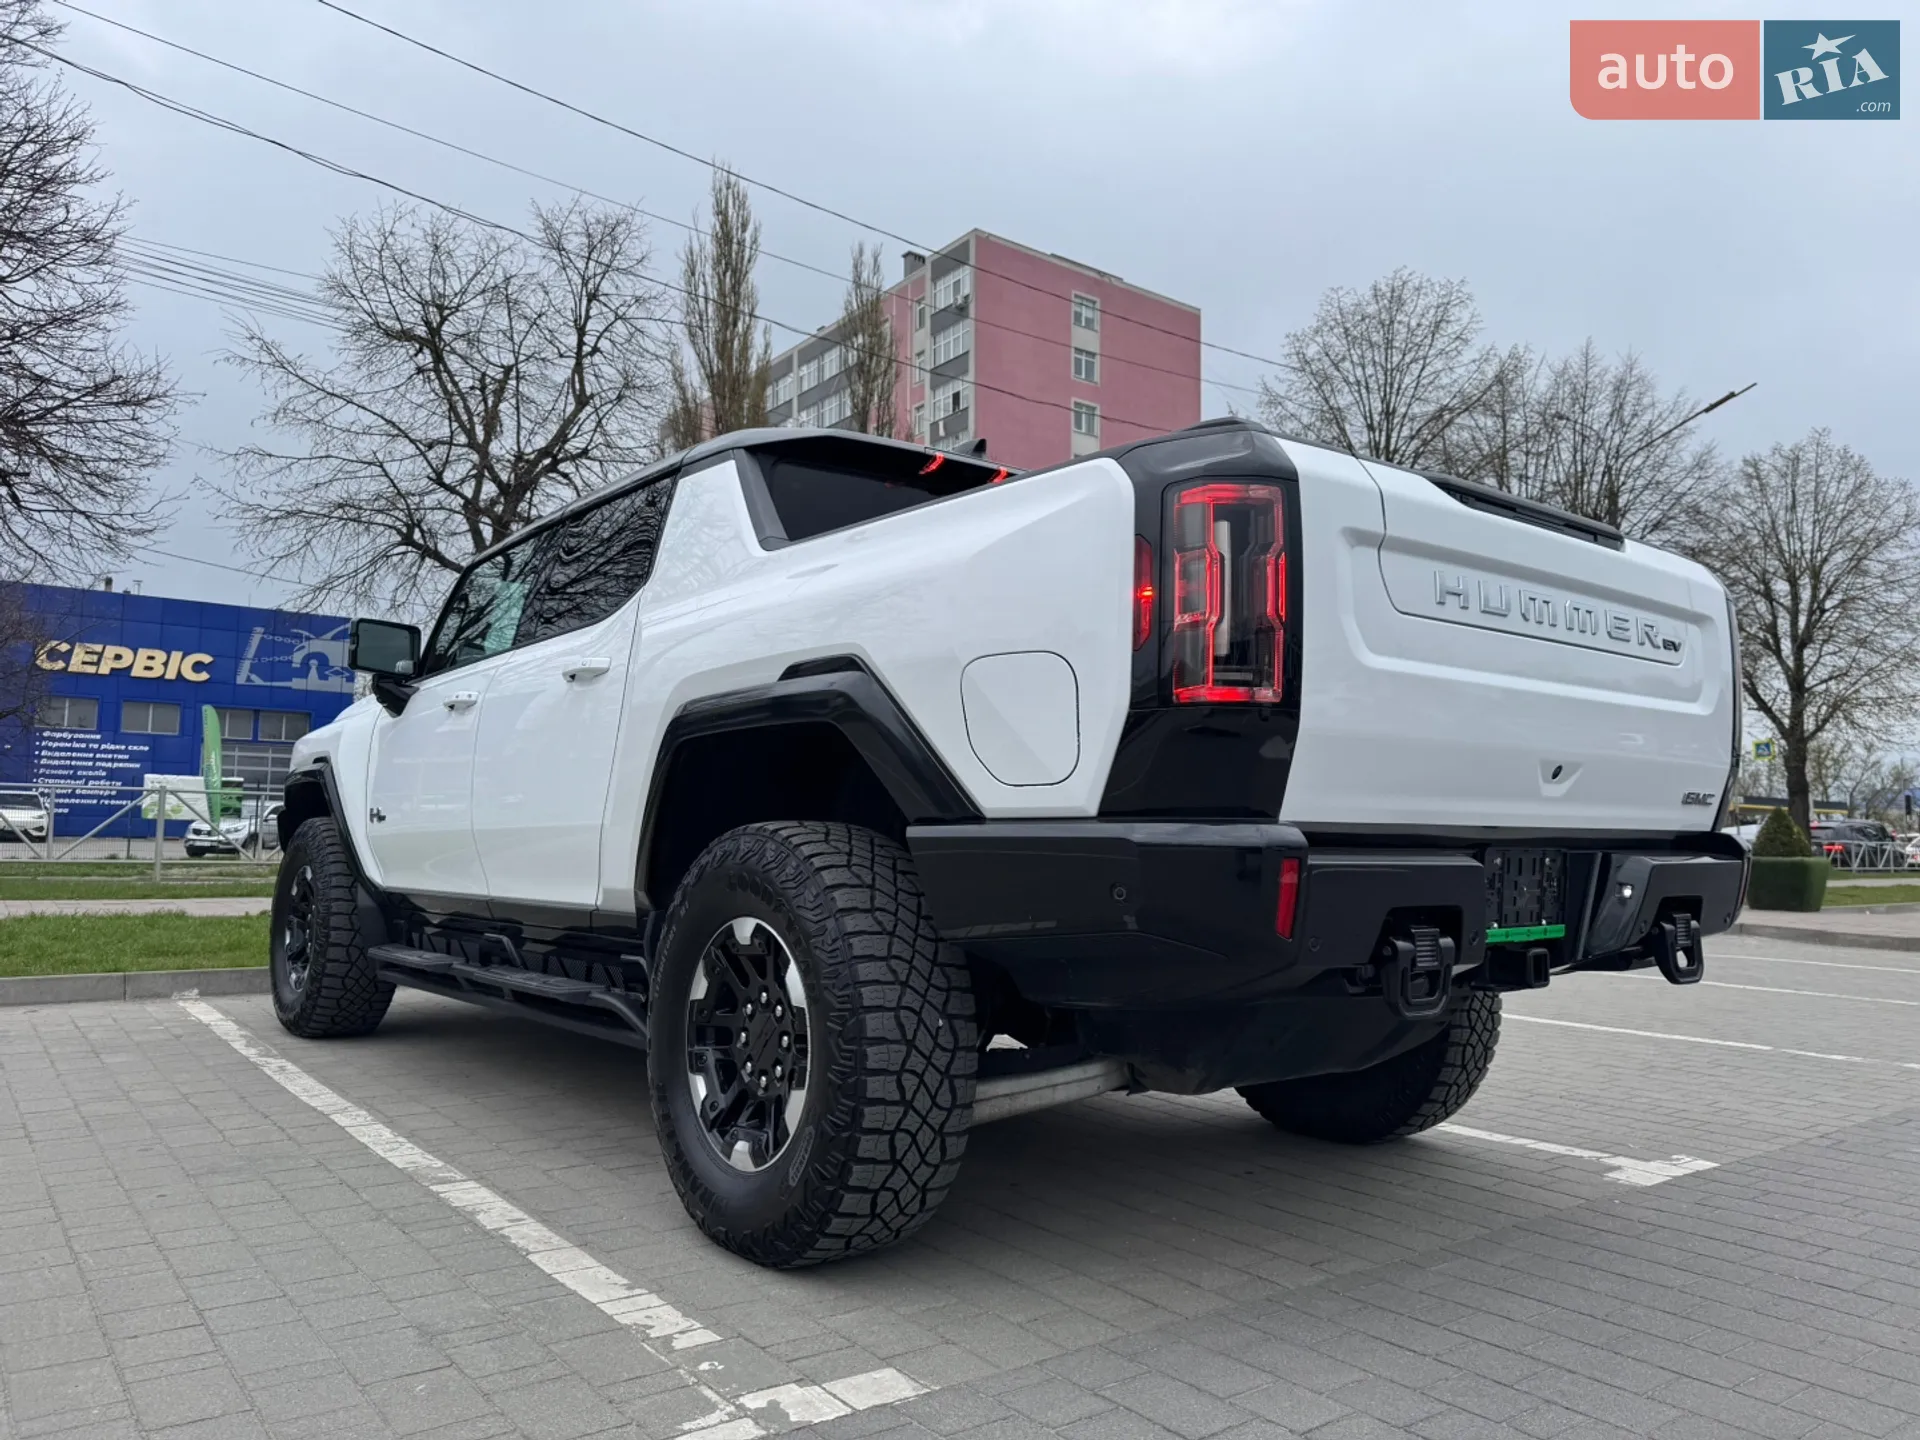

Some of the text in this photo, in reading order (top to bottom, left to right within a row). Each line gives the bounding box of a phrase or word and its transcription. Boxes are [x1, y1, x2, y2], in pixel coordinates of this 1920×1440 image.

[1433, 570, 1682, 652] HUMMER EV
[34, 639, 215, 683] СЕРВІС
[42, 731, 102, 740] Фарбування
[41, 750, 94, 758] Видалення
